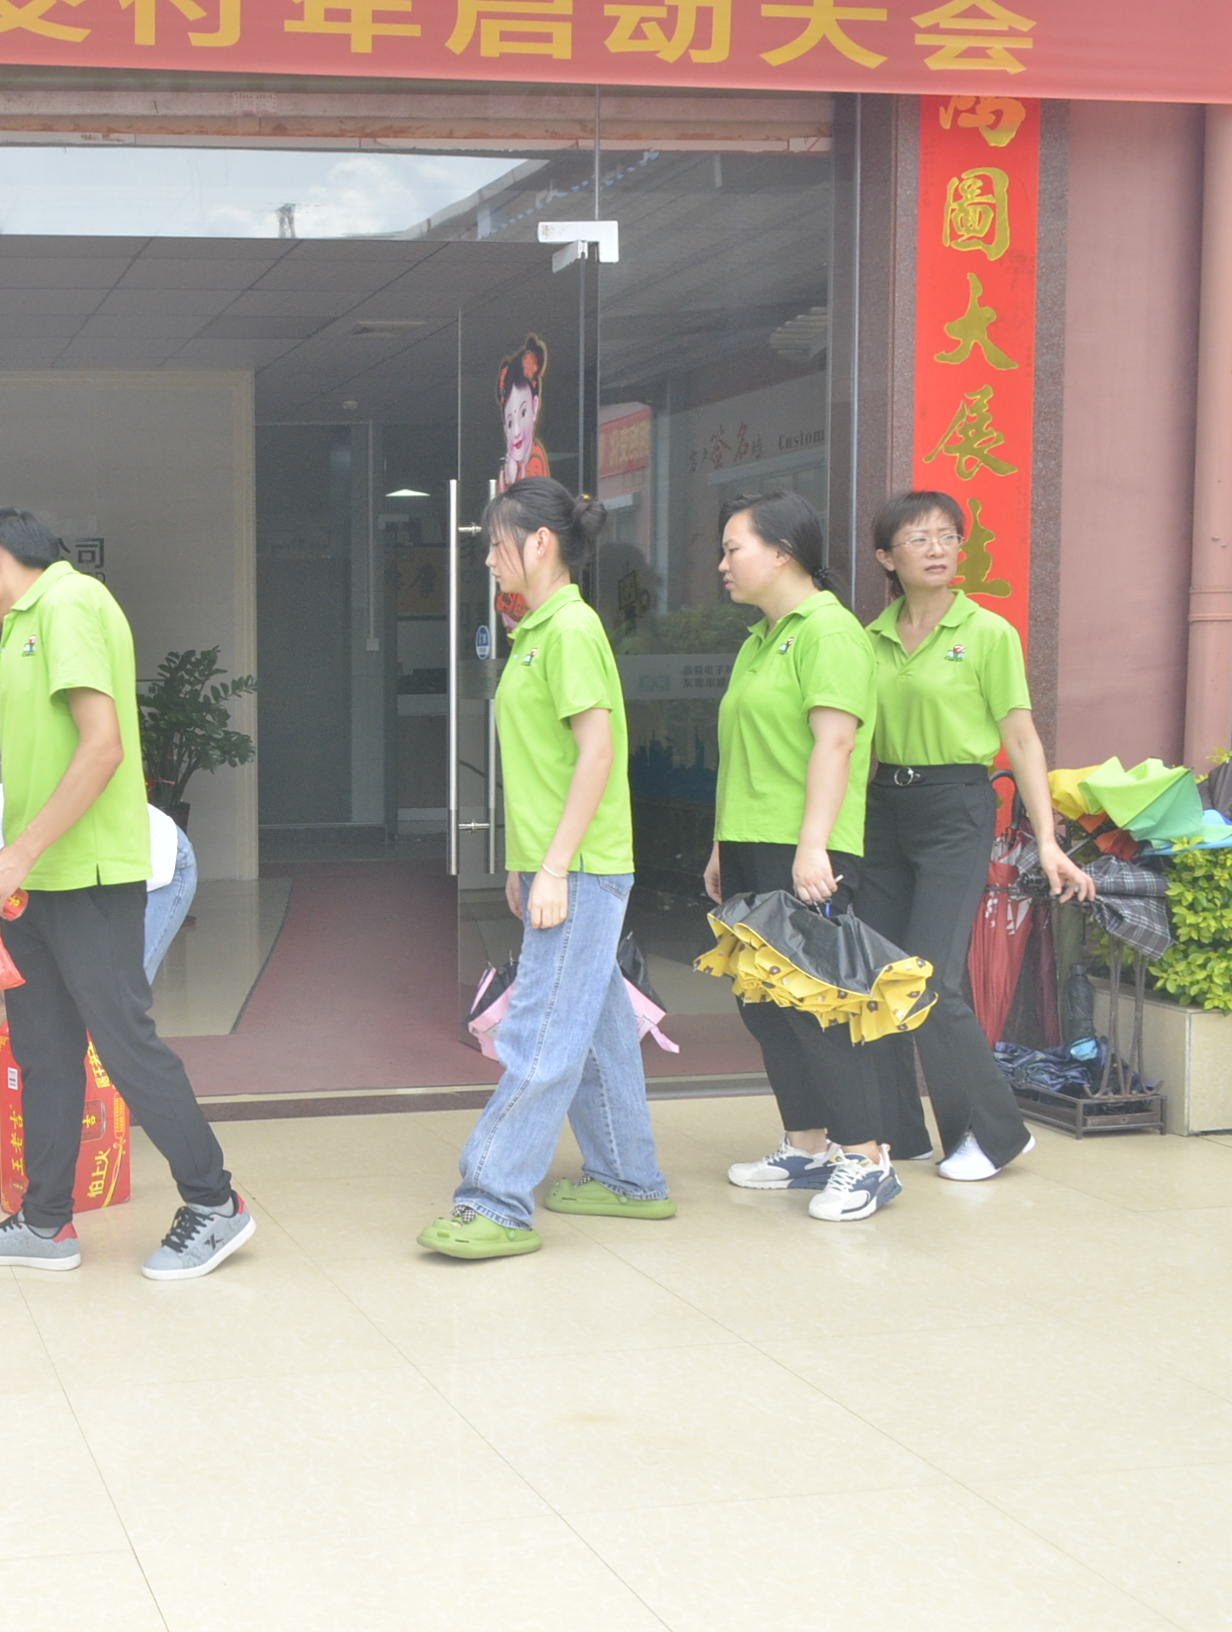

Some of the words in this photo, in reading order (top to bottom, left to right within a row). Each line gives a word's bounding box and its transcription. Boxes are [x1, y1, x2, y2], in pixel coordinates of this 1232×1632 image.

[9, 1110, 25, 1177] 王老吉
[87, 1148, 112, 1198] 怕上火
